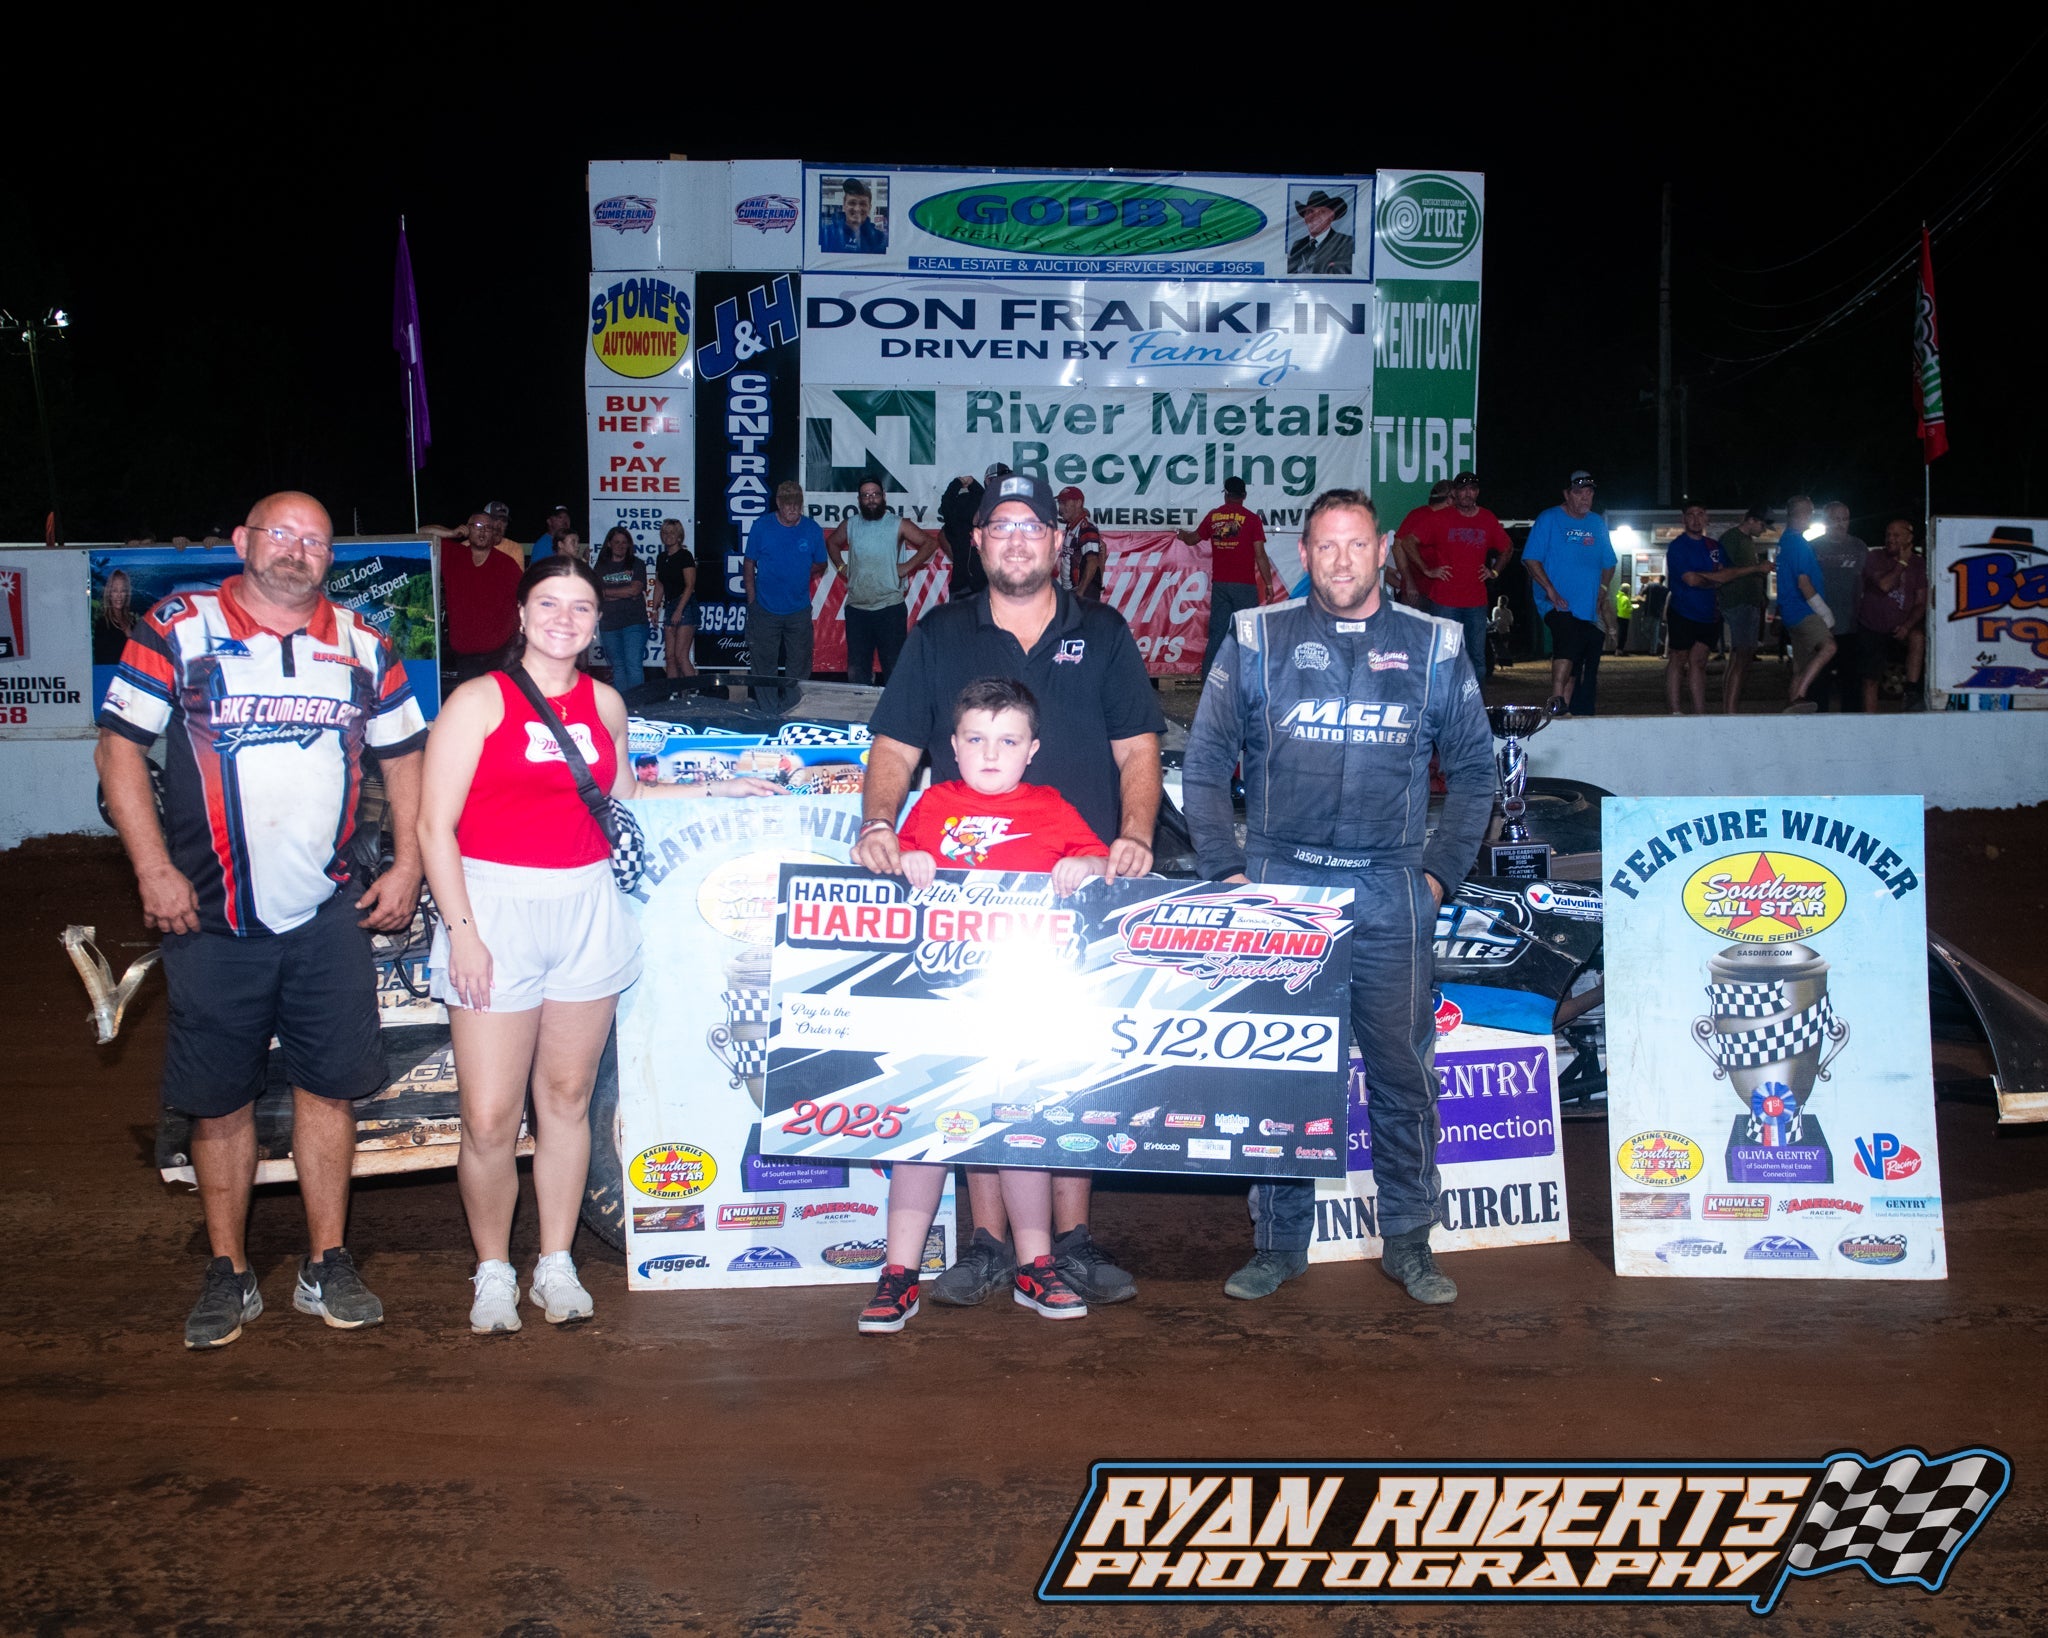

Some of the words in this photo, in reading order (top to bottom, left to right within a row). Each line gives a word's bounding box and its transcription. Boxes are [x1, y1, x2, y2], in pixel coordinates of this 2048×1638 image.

[602, 201, 624, 209] LAKE
[957, 195, 1216, 228] GODBY
[596, 209, 653, 220] CUMBERLAND
[738, 209, 796, 220] CUMBERLAND
[1423, 207, 1467, 238] TURF
[950, 226, 1052, 248] REALTY
[1063, 240, 1082, 251] &
[1096, 230, 1223, 251] AUCTION
[918, 257, 955, 270] REAL
[962, 258, 1013, 271] ESTATE
[1018, 260, 1029, 271] &
[1034, 260, 1100, 272] AUCTION
[1106, 261, 1165, 273] SERVICE
[1171, 262, 1214, 273] SINCE
[1221, 263, 1253, 274] 1965
[591, 277, 691, 336] STONE'S
[806, 297, 976, 330] DON
[1002, 300, 1366, 335] FRANKLIN
[697, 274, 799, 379] J&H
[602, 331, 677, 358] AUTOMOTIVE
[1375, 302, 1477, 371] KENTUCKY
[881, 339, 1048, 360] DRIVEN
[1064, 340, 1118, 360] BY
[1128, 329, 1300, 386] Family
[606, 396, 670, 412] BUY
[966, 391, 1124, 435] River
[1151, 392, 1364, 437] Metals
[598, 416, 680, 433] HERE
[1373, 416, 1474, 483] TURF
[610, 457, 667, 472] PAY
[1012, 441, 1317, 496] Recycling
[600, 477, 681, 493] HERE
[617, 508, 662, 518] USED
[808, 504, 928, 523] PROY
[1058, 508, 1198, 525] MERSET
[617, 520, 663, 530] CARS
[350, 556, 384, 583] Local
[369, 572, 409, 600] Expert
[210, 697, 255, 725] LAKE
[255, 697, 362, 727] CUMBERLA
[1279, 700, 1414, 730] MGL
[214, 723, 322, 752] Speedway
[1294, 727, 1343, 742] AUTO
[1353, 728, 1407, 744] SALES
[1294, 849, 1323, 865] Jason
[1324, 856, 1371, 869] Jameson
[1609, 808, 1767, 900] FEATURE
[1782, 808, 1919, 900] WINNER
[795, 882, 890, 905] HAROLD
[966, 885, 1048, 907] Annual
[1704, 873, 1826, 901] Southern
[1553, 897, 1603, 909] Valvoline
[1704, 901, 1752, 916] ALL
[1759, 901, 1826, 916] STAR
[1153, 904, 1229, 926] LAKE
[793, 903, 911, 940] HARD
[928, 908, 1072, 946] GROVE
[1129, 926, 1328, 957] CUMBERLAND
[1717, 926, 1763, 942] RACING
[1768, 926, 1814, 942] SERIES
[1432, 940, 1515, 959] ALES
[1736, 949, 1793, 958] SASDIRT.COM
[1195, 952, 1319, 992] Speedway
[791, 1002, 817, 1019] Pay
[820, 1005, 831, 1017] to
[834, 1004, 850, 1018] the
[796, 1021, 832, 1036] Order
[1111, 1014, 1333, 1063] $12,022
[1434, 1052, 1545, 1100] ENTRY
[1767, 1099, 1781, 1113] 1st
[781, 1100, 910, 1139] 2025
[1437, 1115, 1552, 1144] onnection
[1631, 1133, 1660, 1146] RACING
[1662, 1133, 1690, 1146] SERIES
[643, 1145, 673, 1159] RACING
[675, 1145, 702, 1157] SERIES
[1631, 1145, 1690, 1160] Southern
[1737, 1149, 1772, 1160] OLIVIA
[1776, 1149, 1819, 1161] GENTRY
[1854, 1133, 1900, 1180] VP
[643, 1158, 702, 1173] Southern
[1632, 1160, 1654, 1169] ALL
[1658, 1160, 1690, 1169] STAR
[1887, 1157, 1922, 1176] Racing
[643, 1173, 666, 1182] ALL
[670, 1172, 703, 1182] STAR
[769, 1170, 796, 1178] Southern
[647, 1186, 700, 1198] SASDIRT.COM
[722, 1206, 780, 1221] KNOWLES
[801, 1202, 879, 1219] AMERICAN
[1440, 1181, 1560, 1231] CIRCLE
[1708, 1198, 1765, 1212] KNOWLES
[1786, 1197, 1864, 1215] AMERICAN
[1886, 1200, 1927, 1209] GENTRY
[1668, 1242, 1727, 1257] ugged.
[646, 1256, 710, 1272] rugged.
